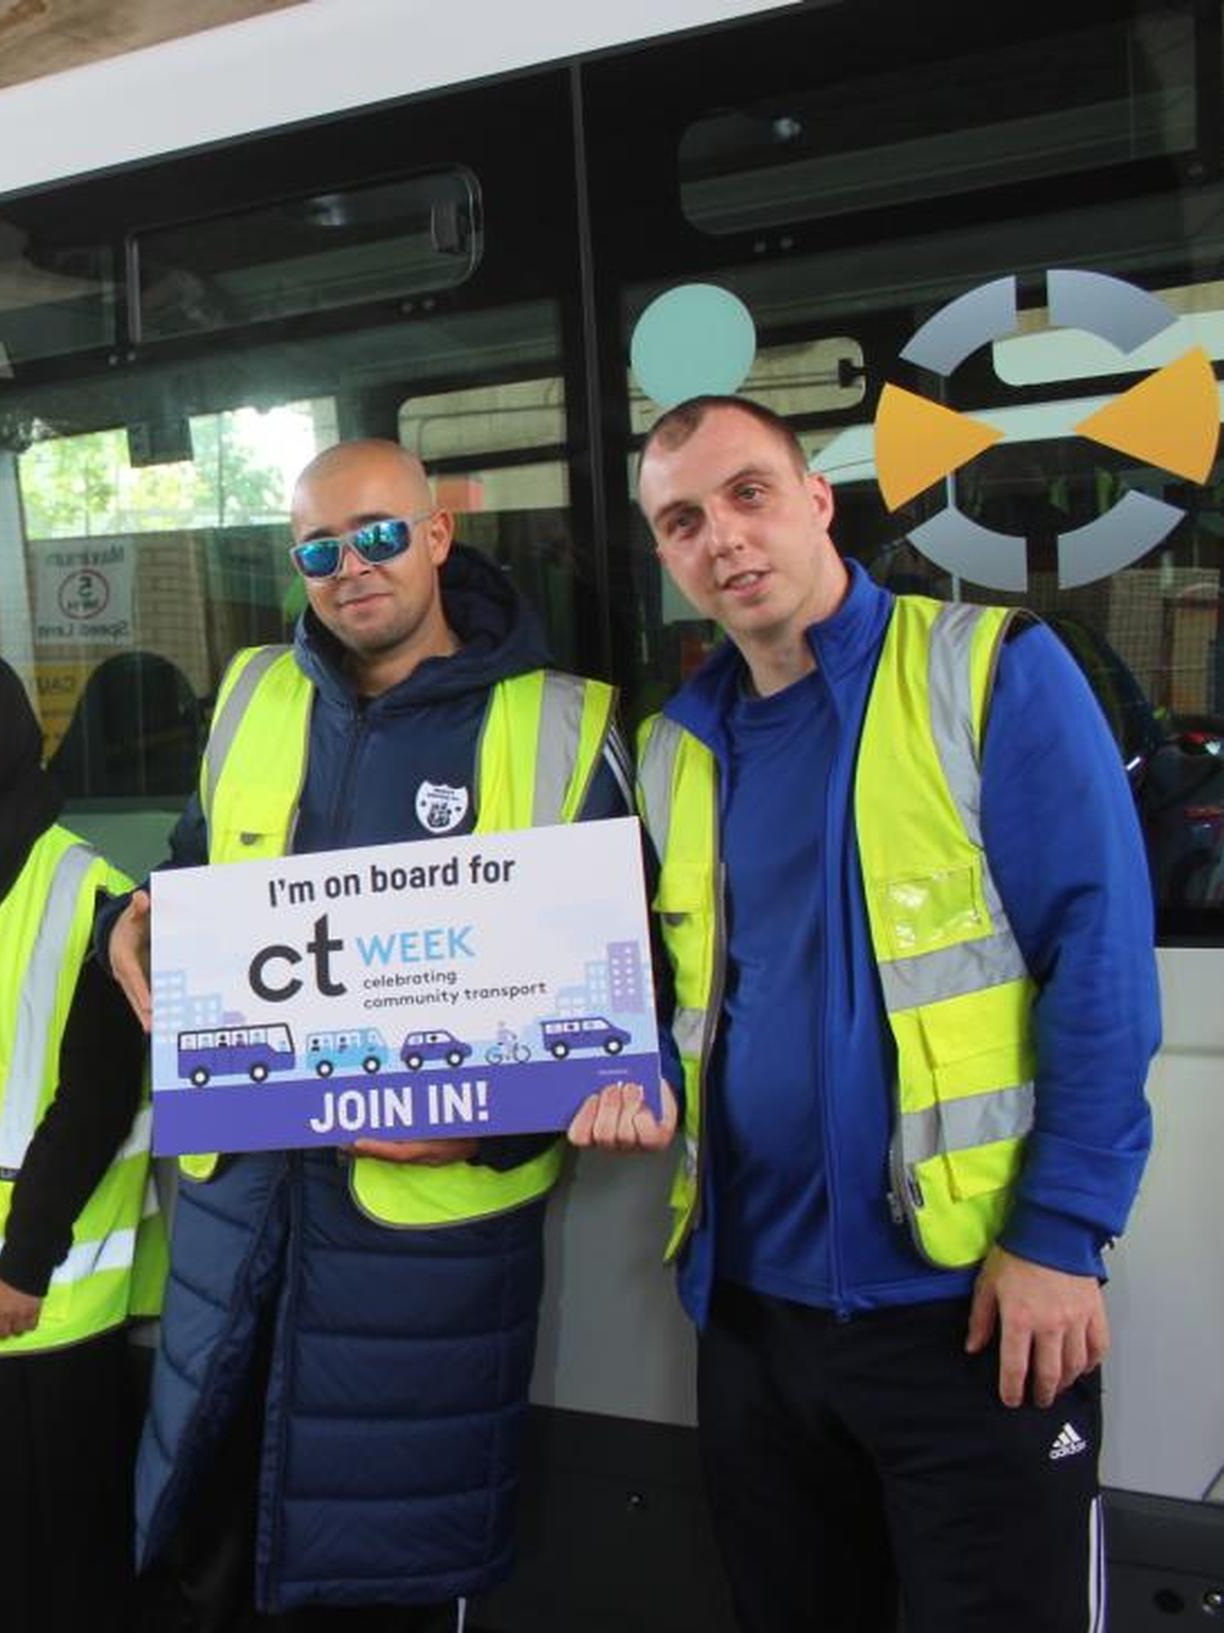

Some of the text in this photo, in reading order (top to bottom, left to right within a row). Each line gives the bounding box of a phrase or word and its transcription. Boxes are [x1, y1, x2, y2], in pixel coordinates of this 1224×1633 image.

[269, 854, 516, 908] I'm on board for
[249, 912, 476, 1003] ct WEEK
[363, 968, 458, 990] celebrating
[363, 980, 547, 1010] community transport
[309, 1080, 490, 1134] JOIN IN!
